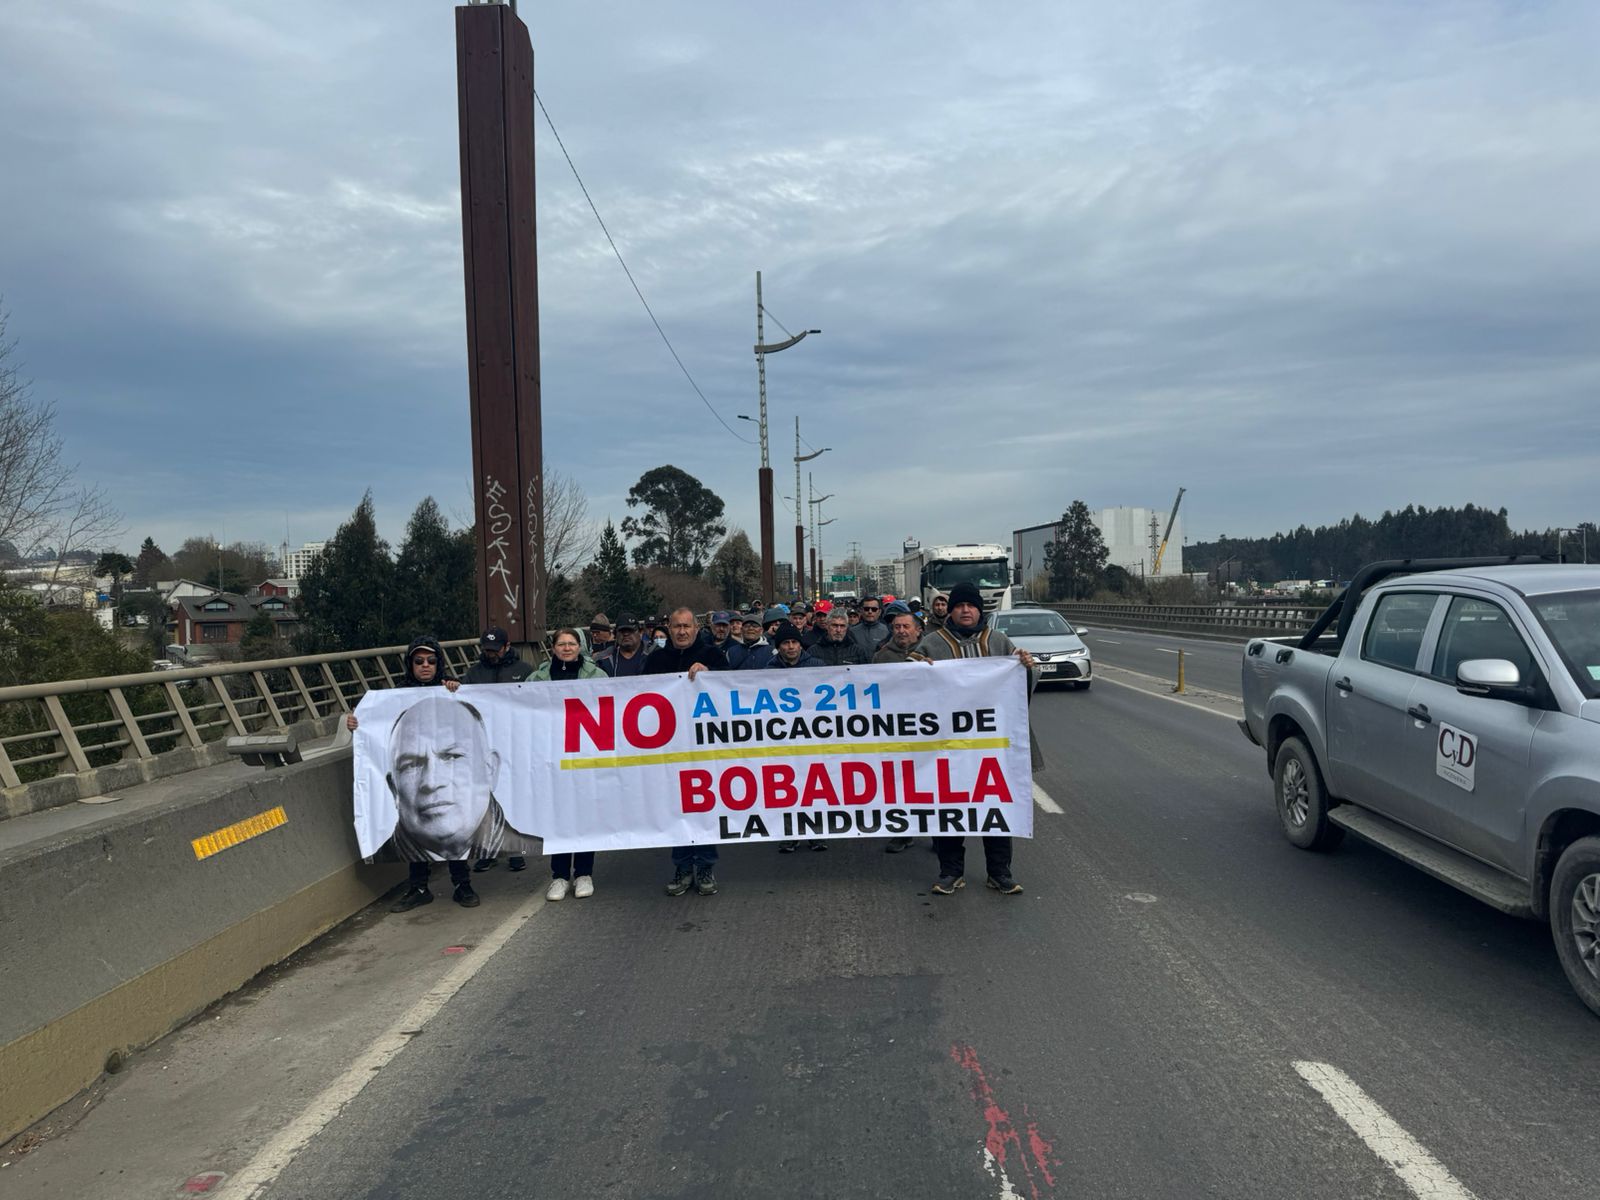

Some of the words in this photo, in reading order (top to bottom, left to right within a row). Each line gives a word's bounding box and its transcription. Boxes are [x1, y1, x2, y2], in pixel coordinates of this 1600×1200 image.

[691, 690, 719, 719] A
[728, 686, 803, 717] LAS
[813, 682, 882, 712] 211
[563, 692, 677, 753] NO
[695, 712, 940, 745] INDICACIONES
[952, 708, 997, 733] DE
[1439, 728, 1475, 768] CyD
[679, 757, 1013, 813] BOBADILLA
[719, 814, 769, 840] LA
[783, 807, 1011, 836] INDUSTRIA
